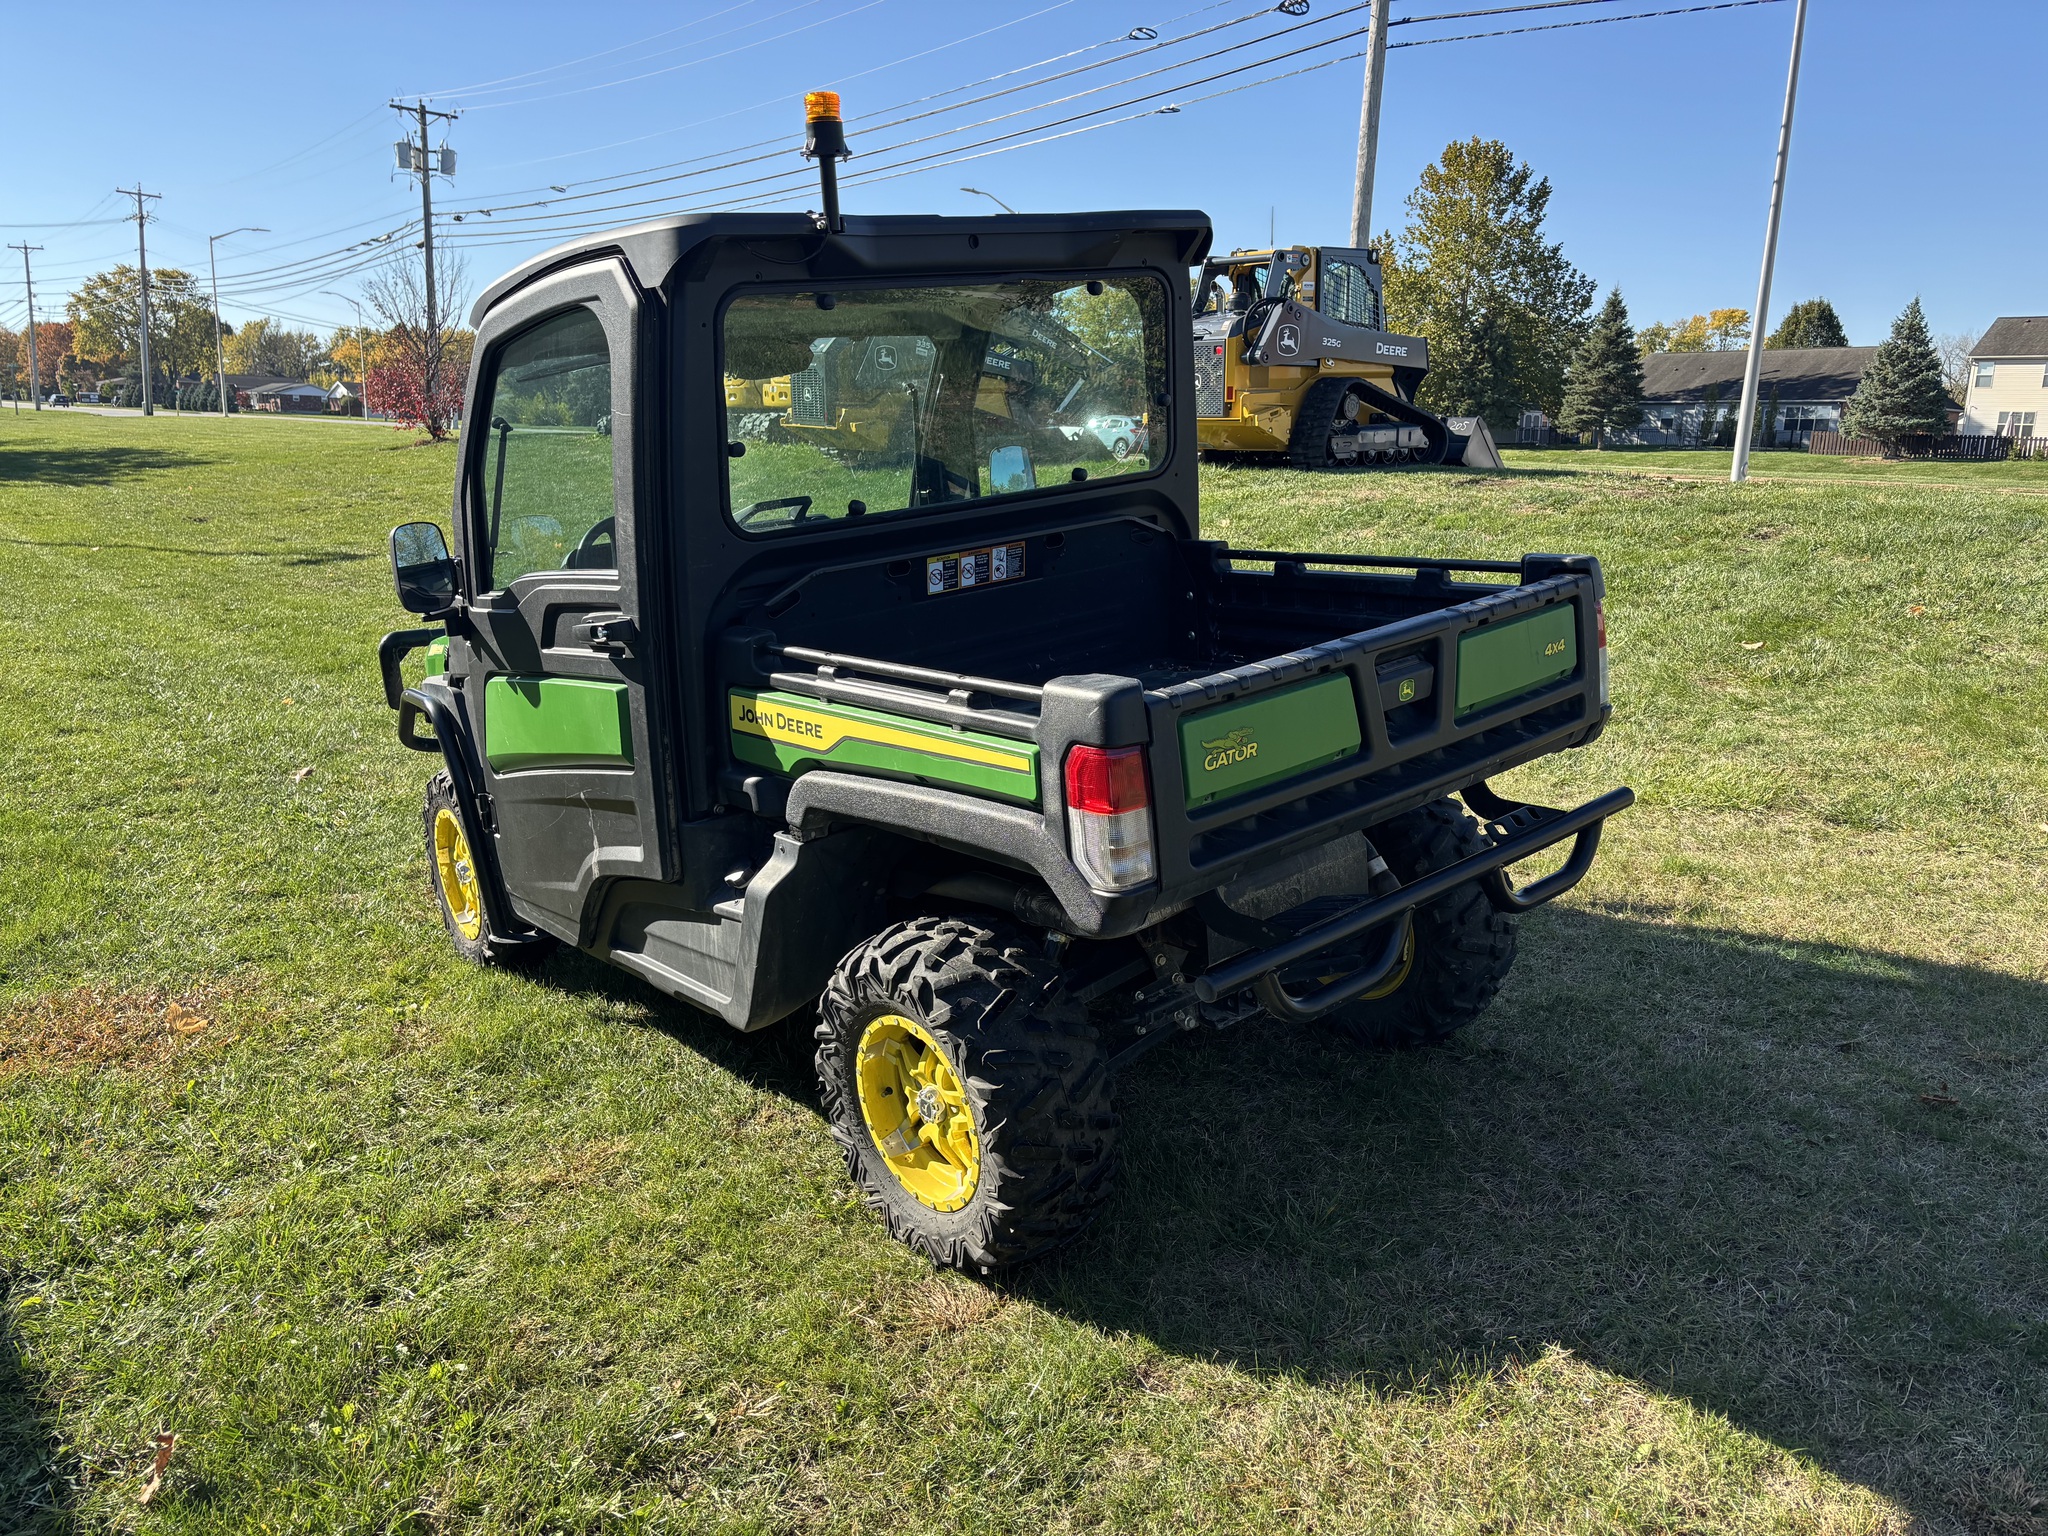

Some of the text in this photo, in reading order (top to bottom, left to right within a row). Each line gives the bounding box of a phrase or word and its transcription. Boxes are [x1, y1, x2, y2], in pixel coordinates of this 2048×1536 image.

[1032, 328, 1058, 350] DEERE
[1322, 337, 1341, 348] 325G
[1376, 342, 1408, 357] DEERE
[1450, 420, 1470, 431] 205
[739, 705, 823, 739] JOHN DEERE
[1204, 742, 1258, 771] GATOR
